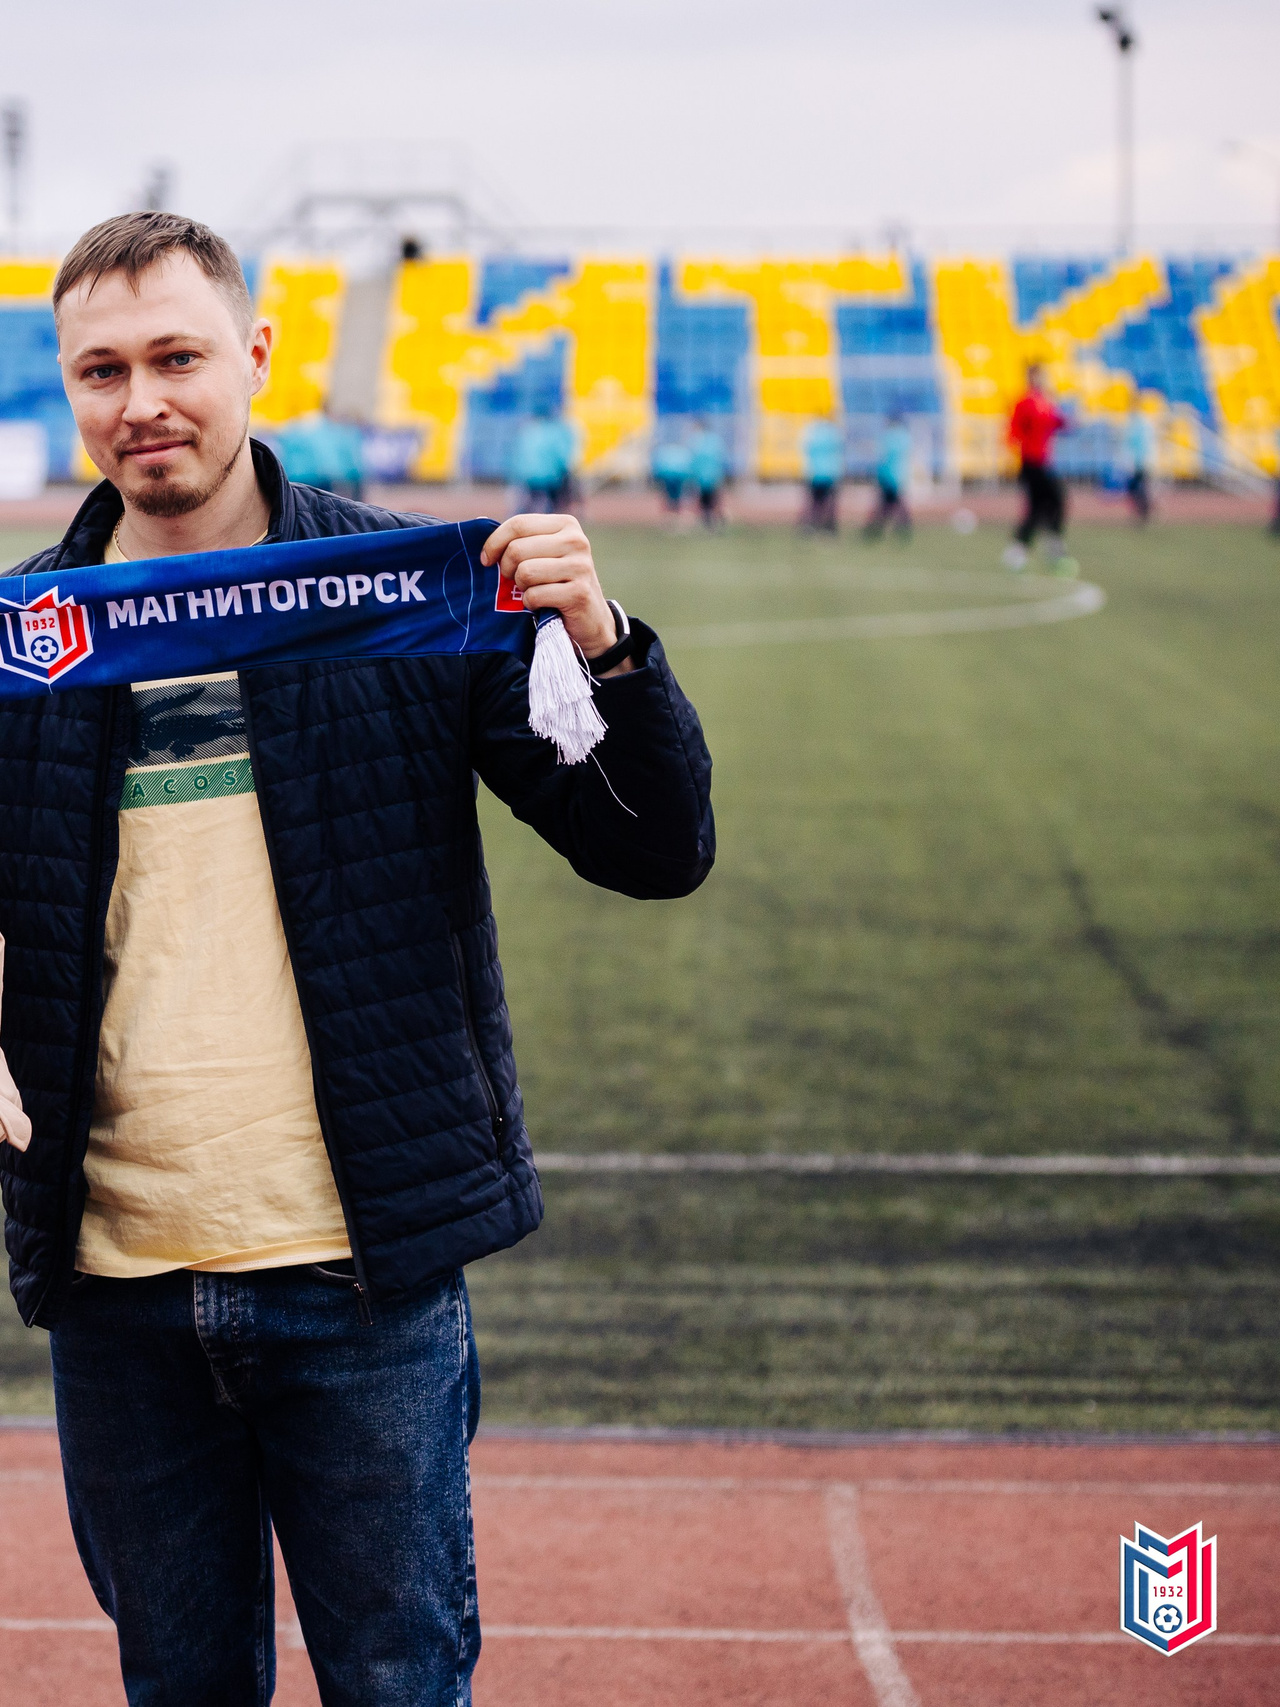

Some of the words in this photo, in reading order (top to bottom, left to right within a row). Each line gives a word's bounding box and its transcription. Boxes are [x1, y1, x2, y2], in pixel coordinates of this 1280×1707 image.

[106, 570, 427, 630] МАГНИТОГОРСК
[25, 617, 56, 631] 1932
[131, 764, 253, 799] ACOS
